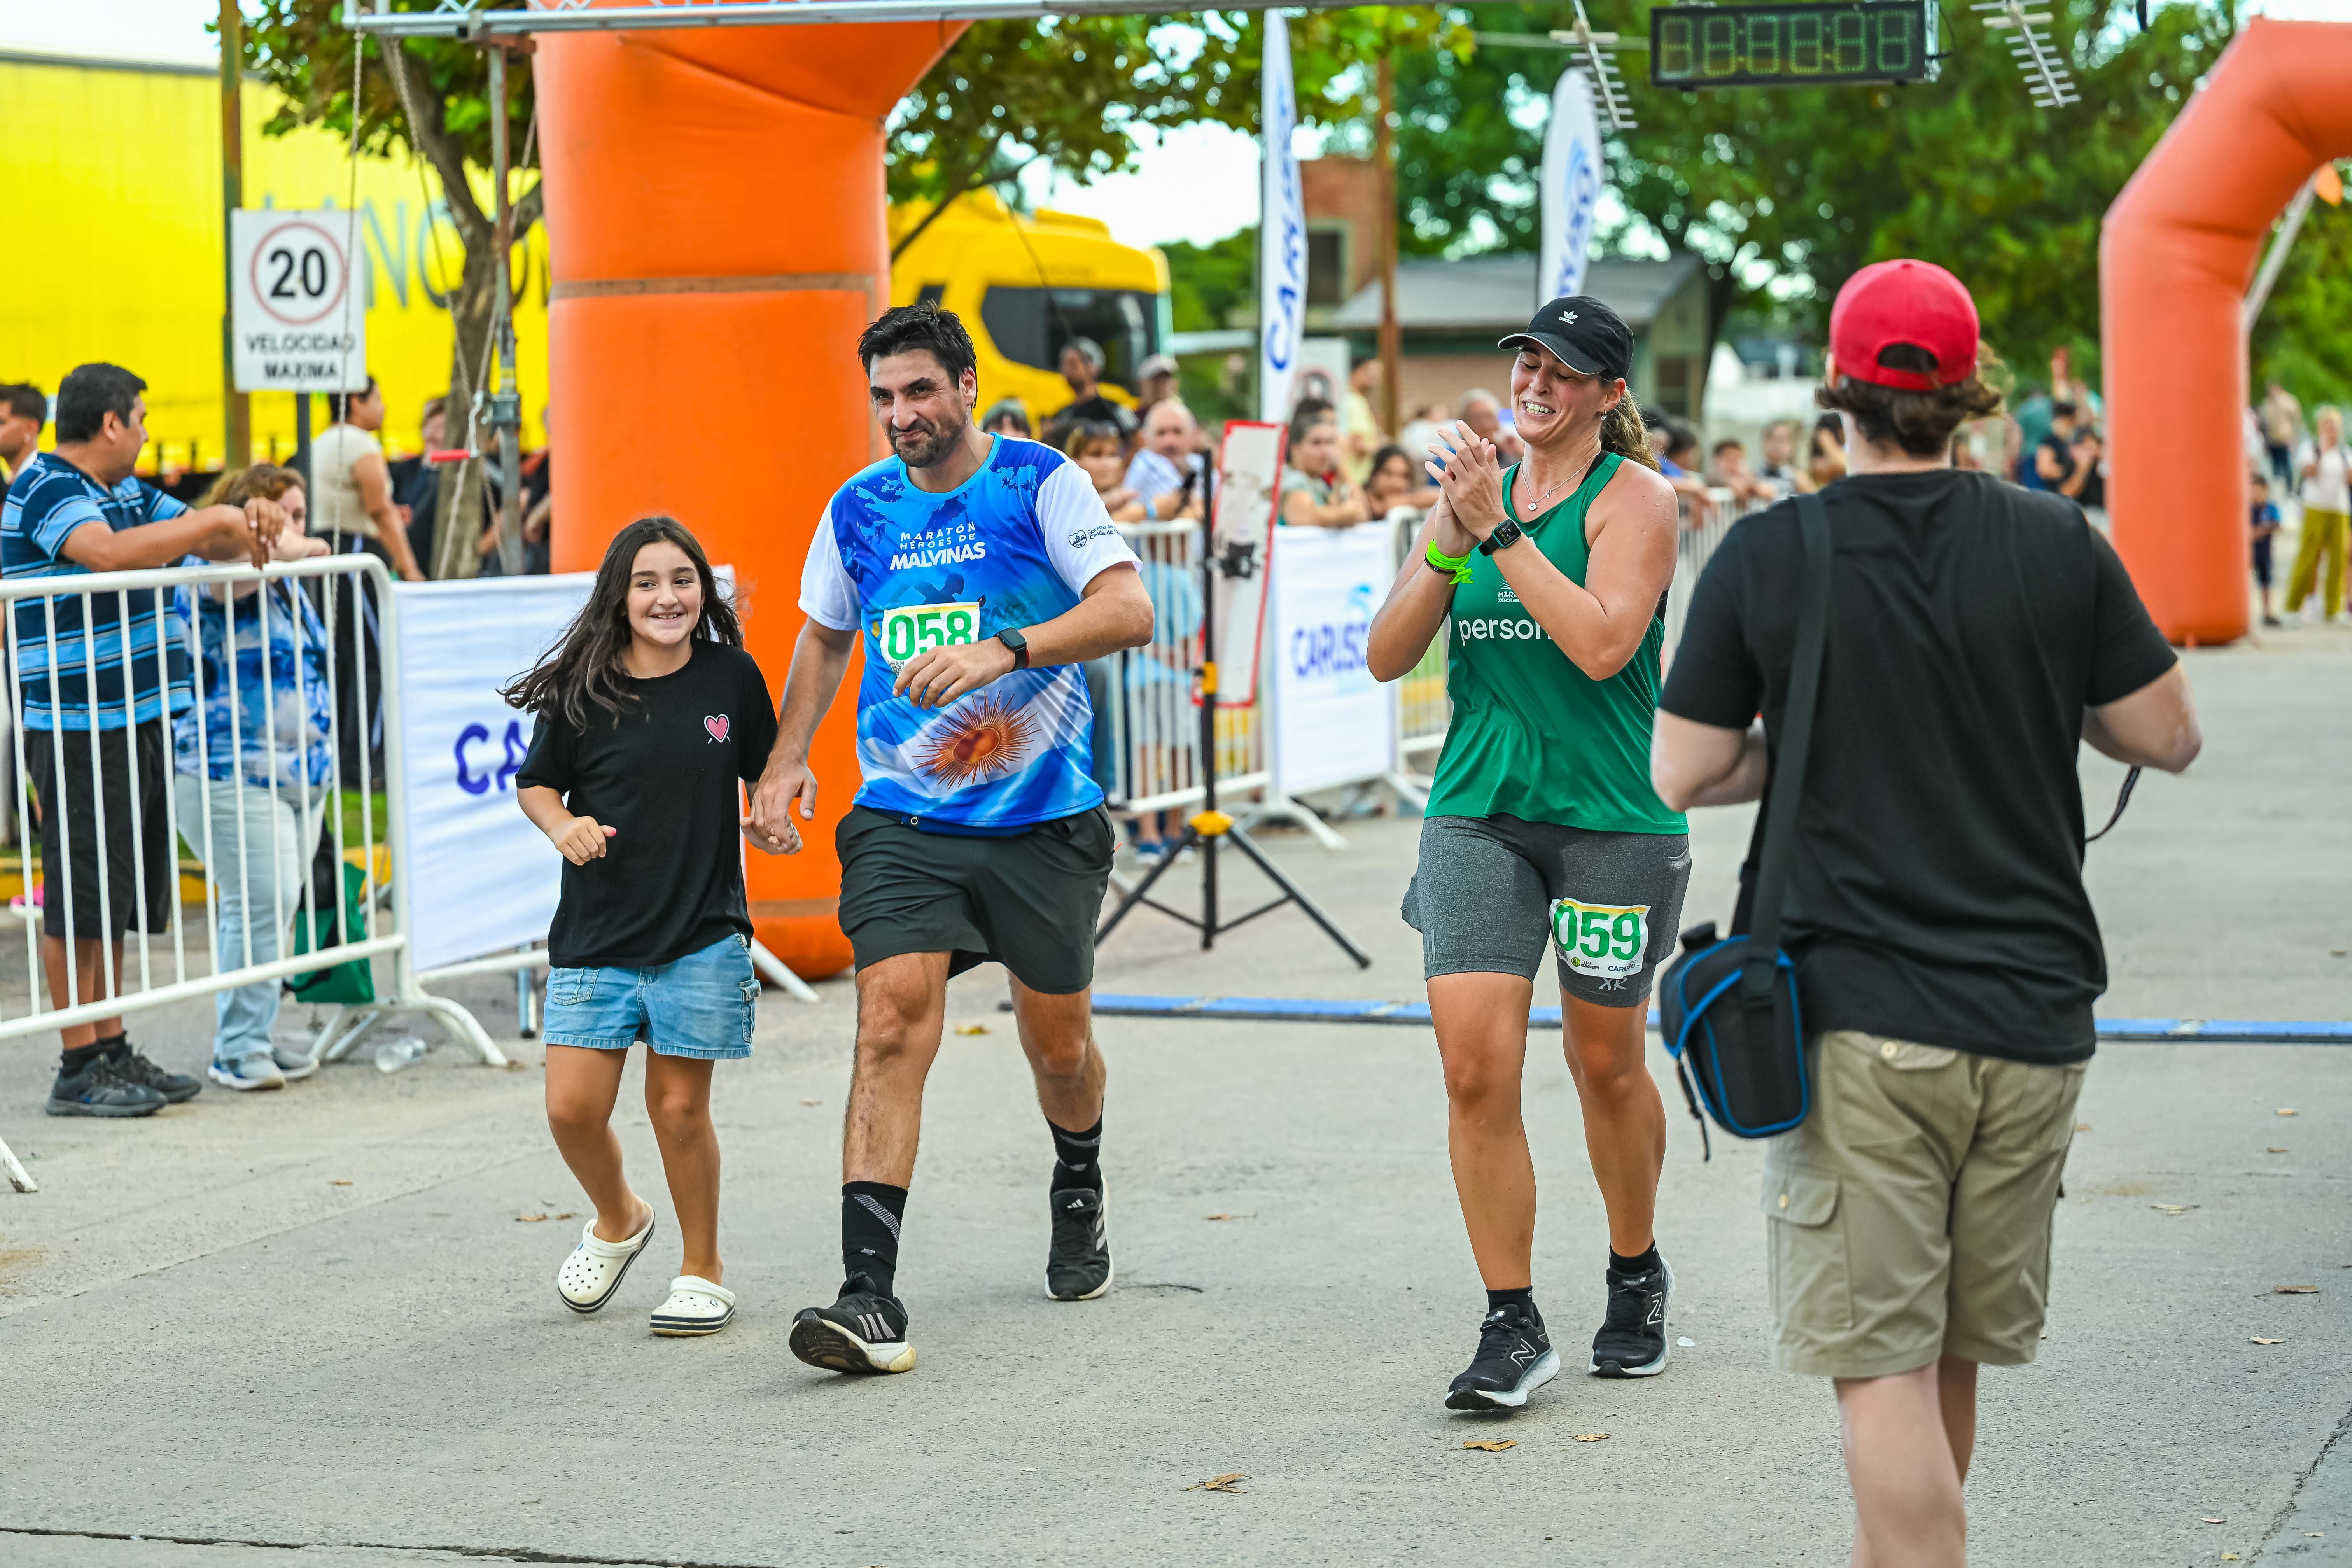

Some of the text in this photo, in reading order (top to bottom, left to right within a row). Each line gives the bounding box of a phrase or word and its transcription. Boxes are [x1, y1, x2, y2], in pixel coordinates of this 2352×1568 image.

[269, 248, 326, 298] 20
[1558, 317, 1574, 325] adidas
[247, 333, 355, 354] VELOCIDAD
[900, 533, 975, 550] HÉROES DE
[901, 522, 975, 541] MARATÓN
[889, 542, 986, 570] MALVINAS
[888, 611, 972, 660] 058
[1553, 905, 1641, 961] 059
